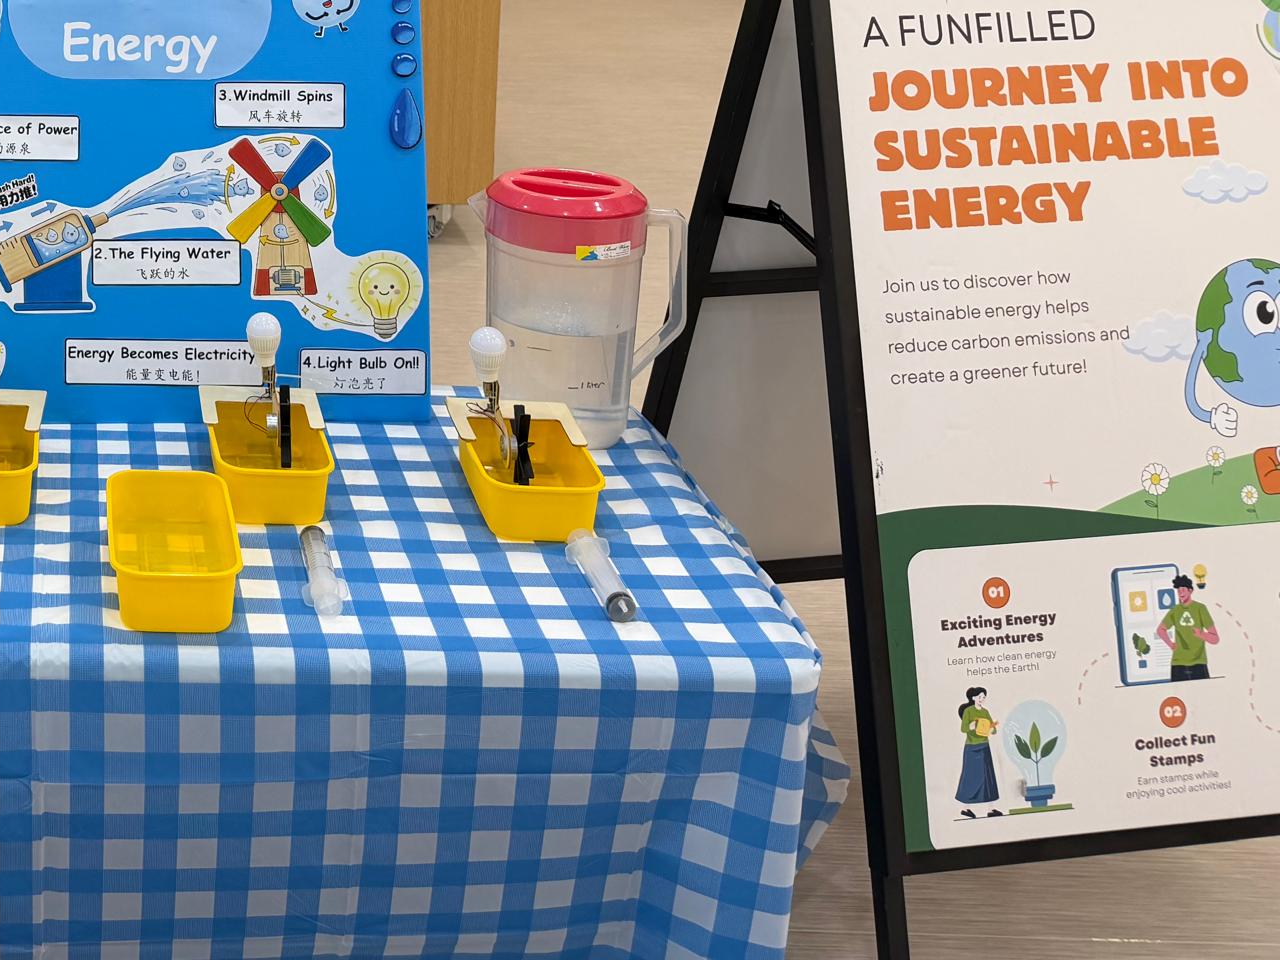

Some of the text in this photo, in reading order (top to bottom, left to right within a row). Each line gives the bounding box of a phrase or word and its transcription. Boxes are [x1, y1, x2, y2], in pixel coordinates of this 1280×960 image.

[863, 9, 1096, 47] A FUNFILLED
[63, 21, 217, 74] Energy
[869, 57, 1249, 112] JOURNEY INTO
[219, 89, 333, 105] 3.Windmill Spins
[248, 109, 303, 123] 风车旋转
[17, 123, 32, 135] of
[38, 123, 78, 135] Power
[873, 116, 1220, 172] SUSTAINABLE
[11, 174, 35, 188] Hard!
[880, 180, 1092, 232] ENERGY
[94, 247, 231, 262] 2.The Flying Water
[136, 267, 190, 280] 飞跃的水
[882, 271, 1071, 294] Join us to discover how
[885, 299, 1089, 324] sustainable energy helps
[888, 325, 1130, 354] reduce carbon emissions and
[68, 346, 255, 364] Energy Becomes Electricity
[302, 356, 420, 372] 4.Light Bulb On!!
[890, 359, 1087, 385] create a greener future!
[988, 586, 1005, 598] 01
[940, 613, 1056, 631] Exciting Energy
[957, 632, 1044, 648] Adventures
[947, 650, 1057, 666] Learn how clean energy
[967, 662, 1040, 677] helps the Earth!
[1164, 705, 1182, 718] 02
[1135, 733, 1216, 750] Collect Fun
[1150, 753, 1204, 767] Stamps
[1137, 770, 1219, 785] Earn stamps while
[1126, 780, 1231, 799] enjoying cool activities!
